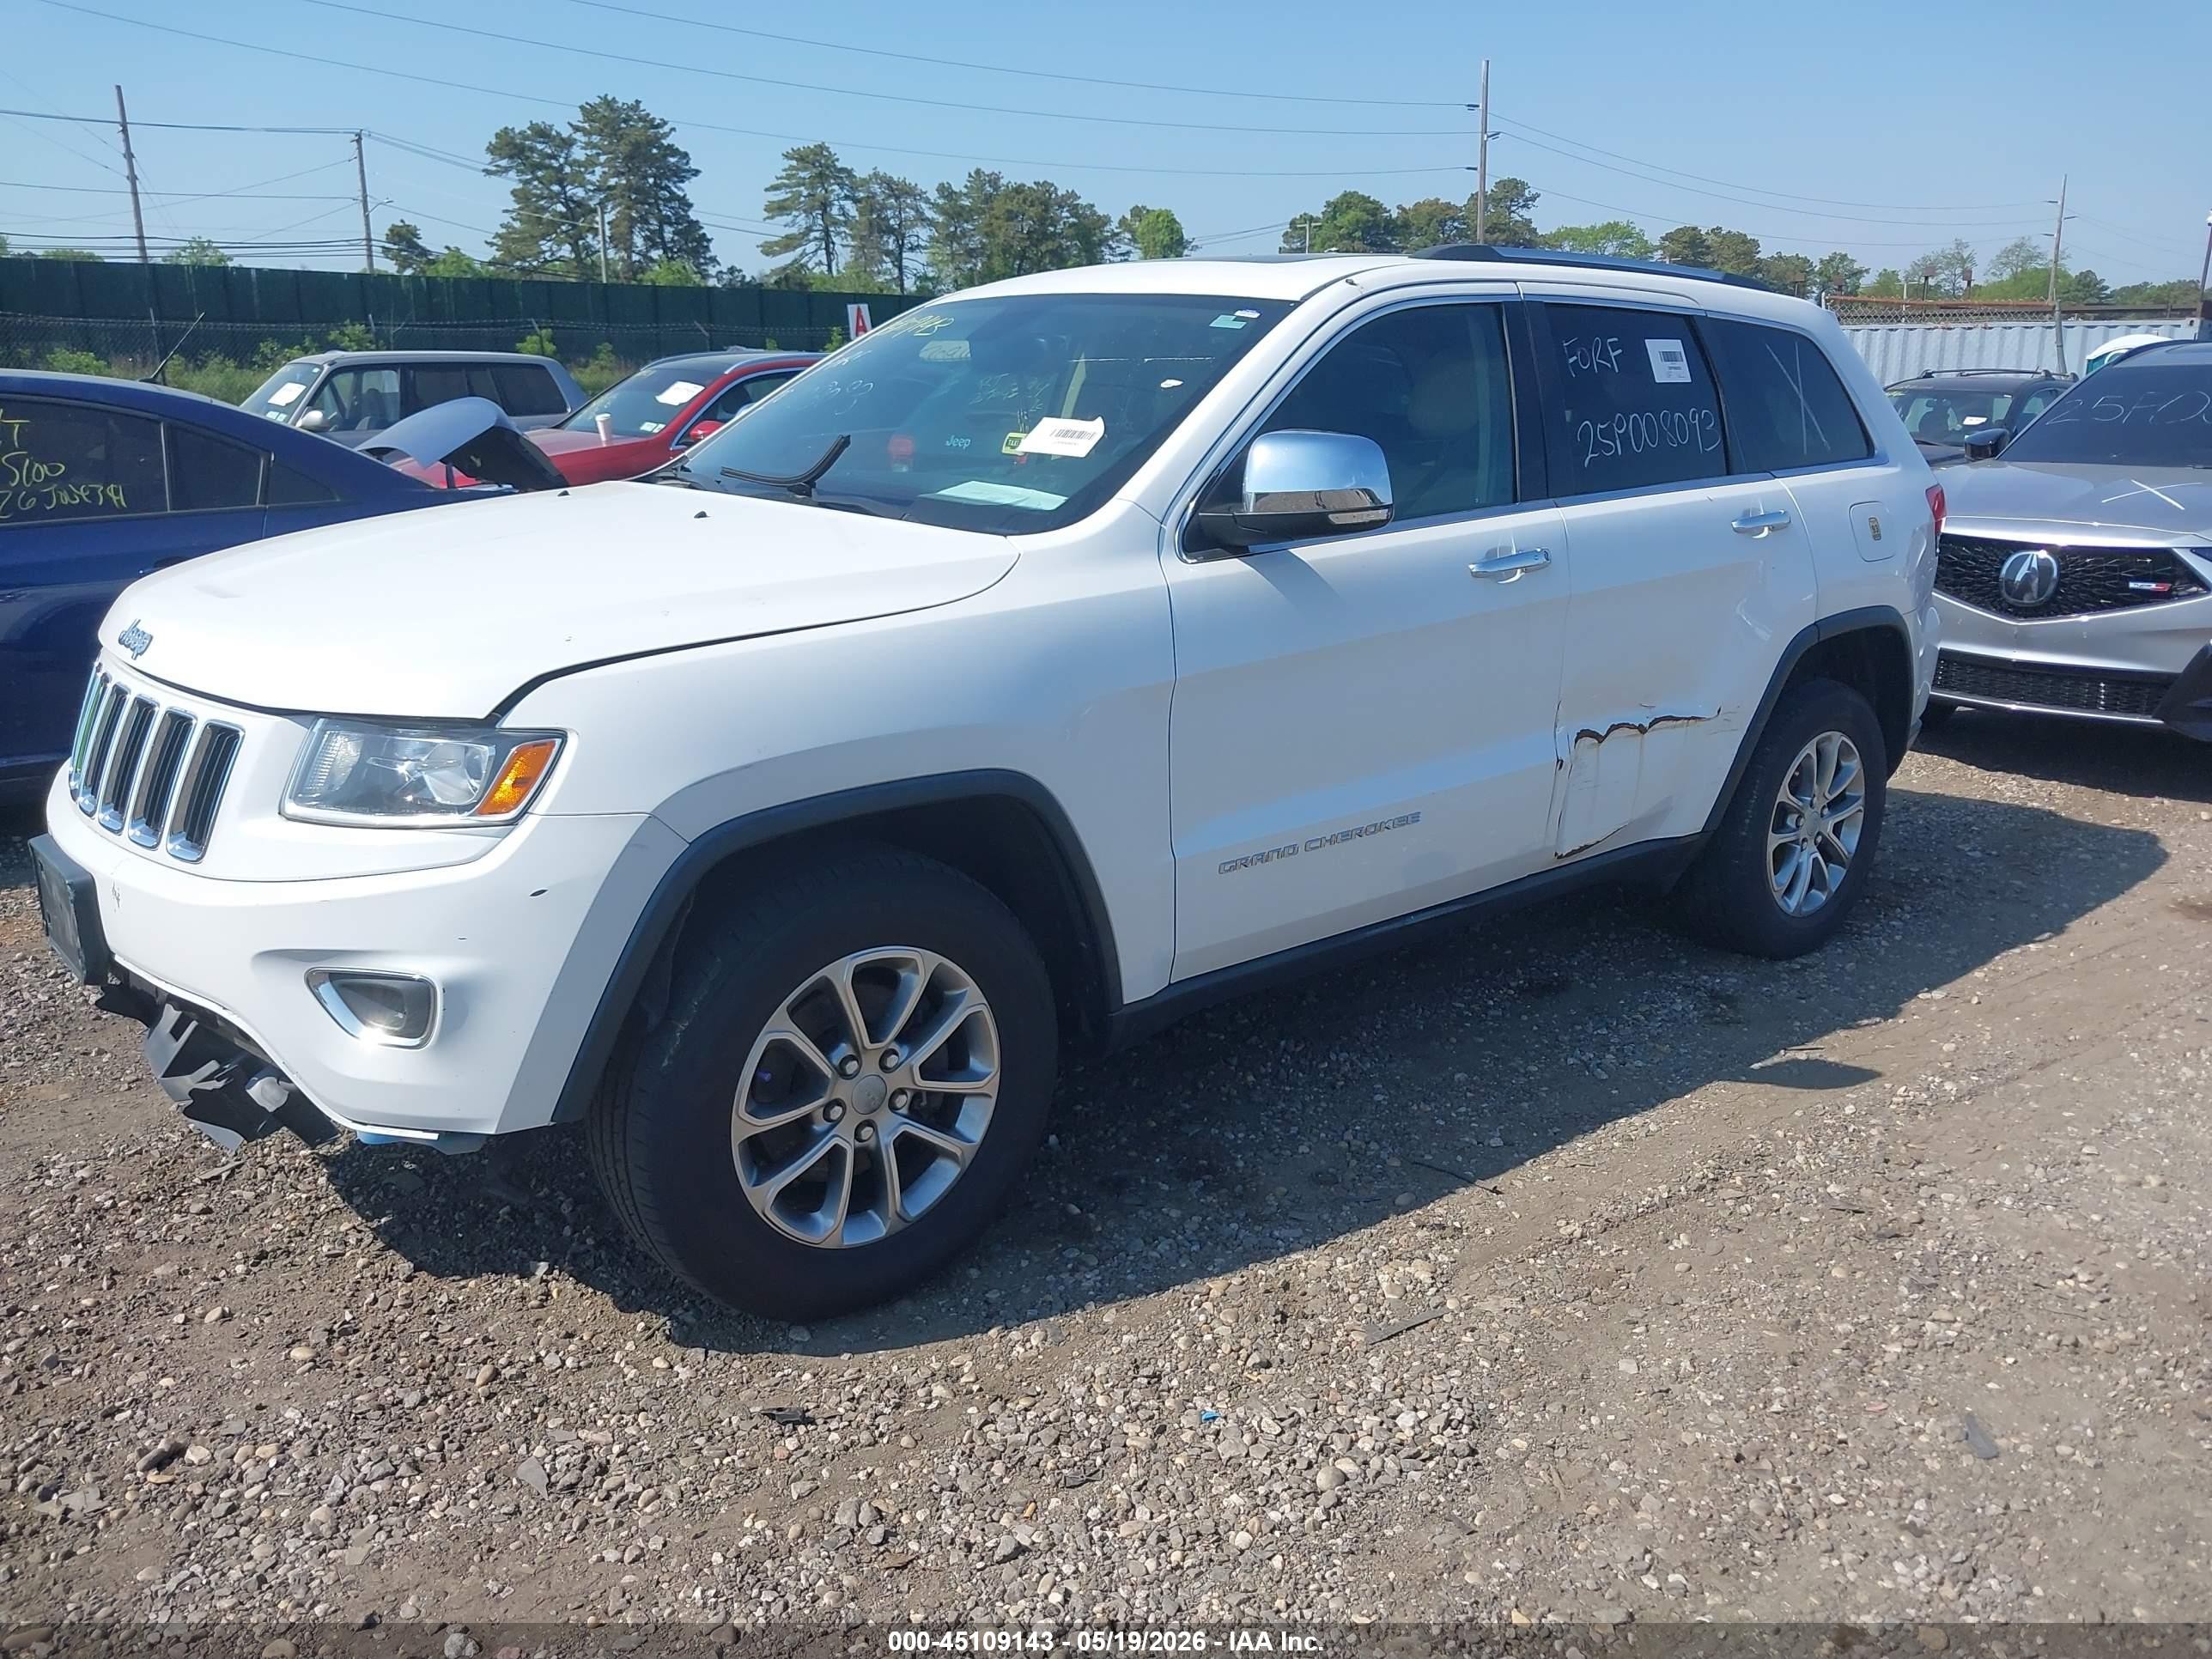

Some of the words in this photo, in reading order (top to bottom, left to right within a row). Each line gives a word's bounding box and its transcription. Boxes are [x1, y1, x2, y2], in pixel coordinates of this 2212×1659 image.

[854, 305, 868, 337] A
[945, 434, 972, 451] Jeep
[1577, 406, 1723, 468] 25P008093
[1218, 843, 1300, 875] GRAND
[1304, 811, 1422, 853] CHEROKEE
